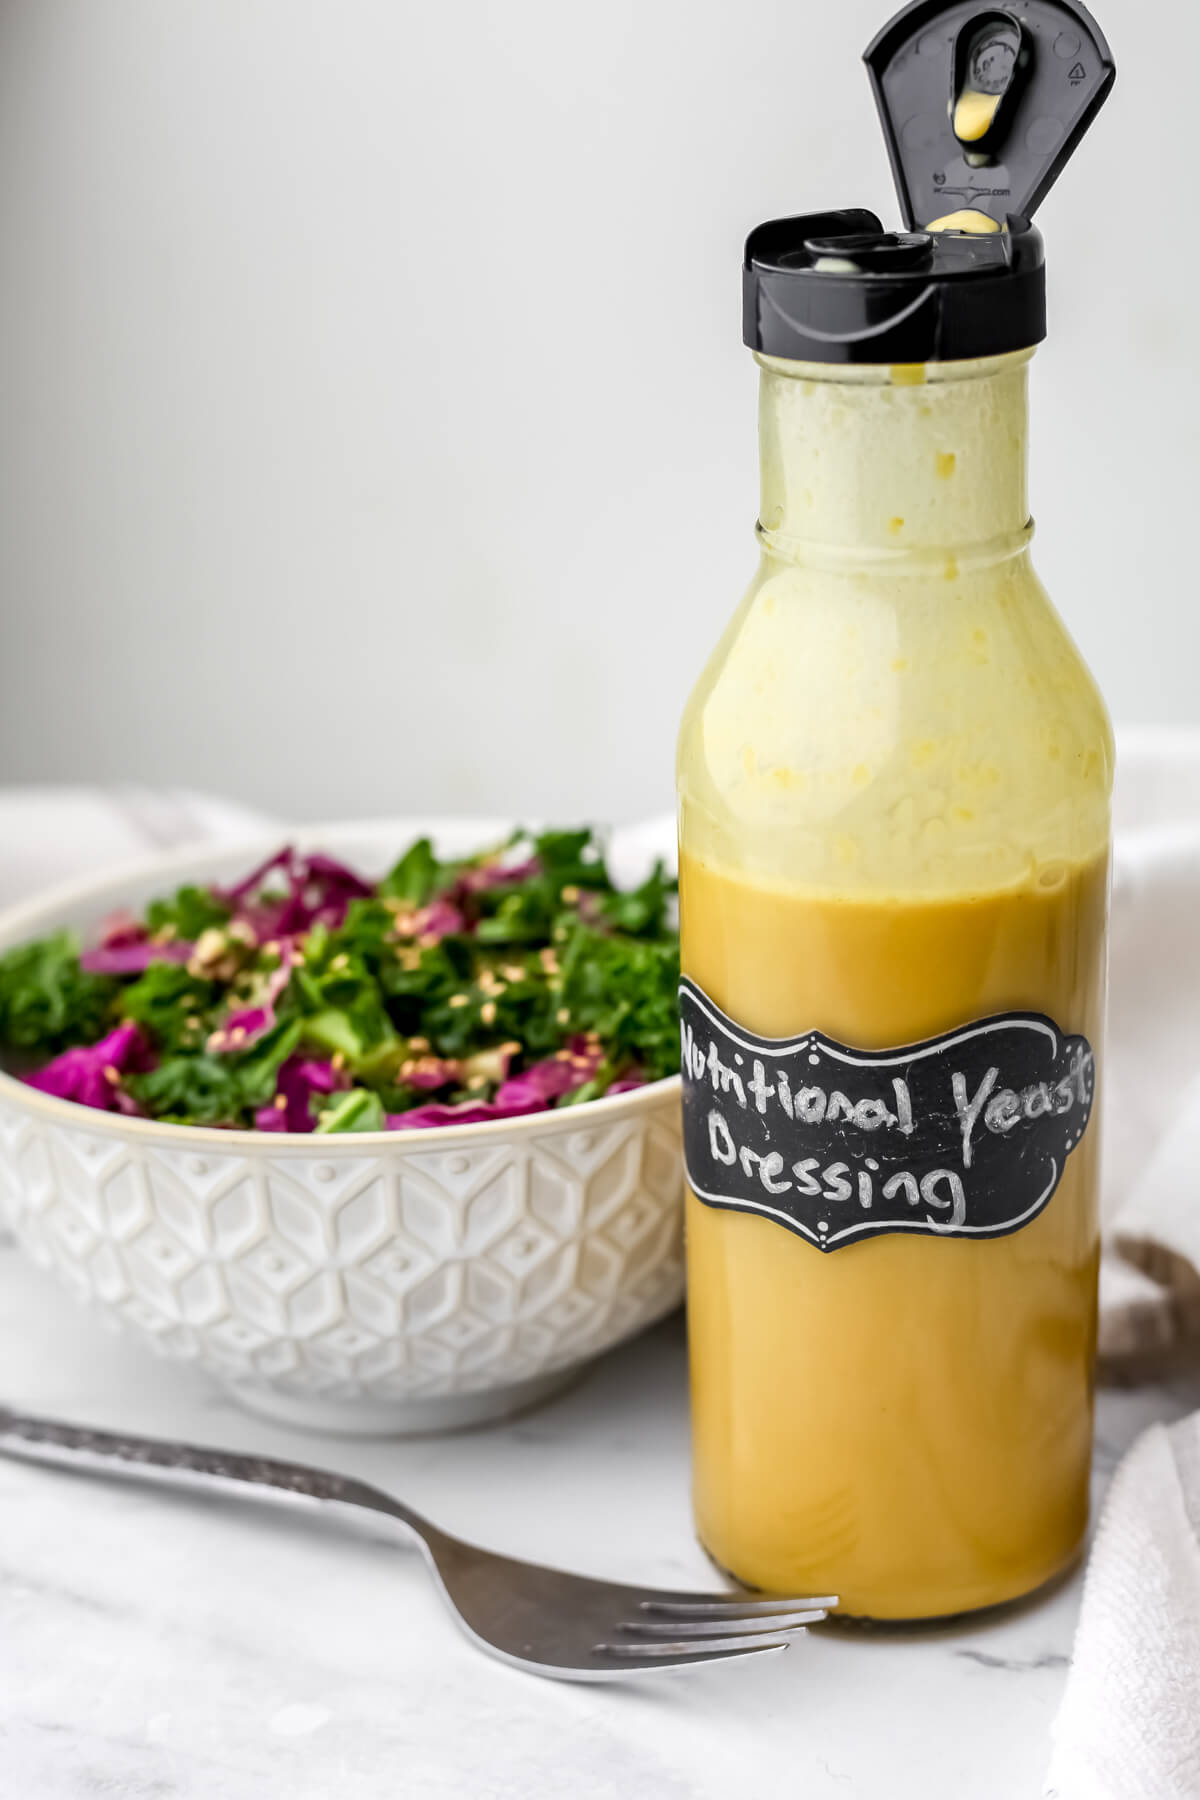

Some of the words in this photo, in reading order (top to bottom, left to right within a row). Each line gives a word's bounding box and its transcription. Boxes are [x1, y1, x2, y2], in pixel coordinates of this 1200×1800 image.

[679, 1018, 916, 1135] Nutritional
[951, 1041, 1092, 1168] Yeast
[708, 1109, 967, 1233] Dressing
